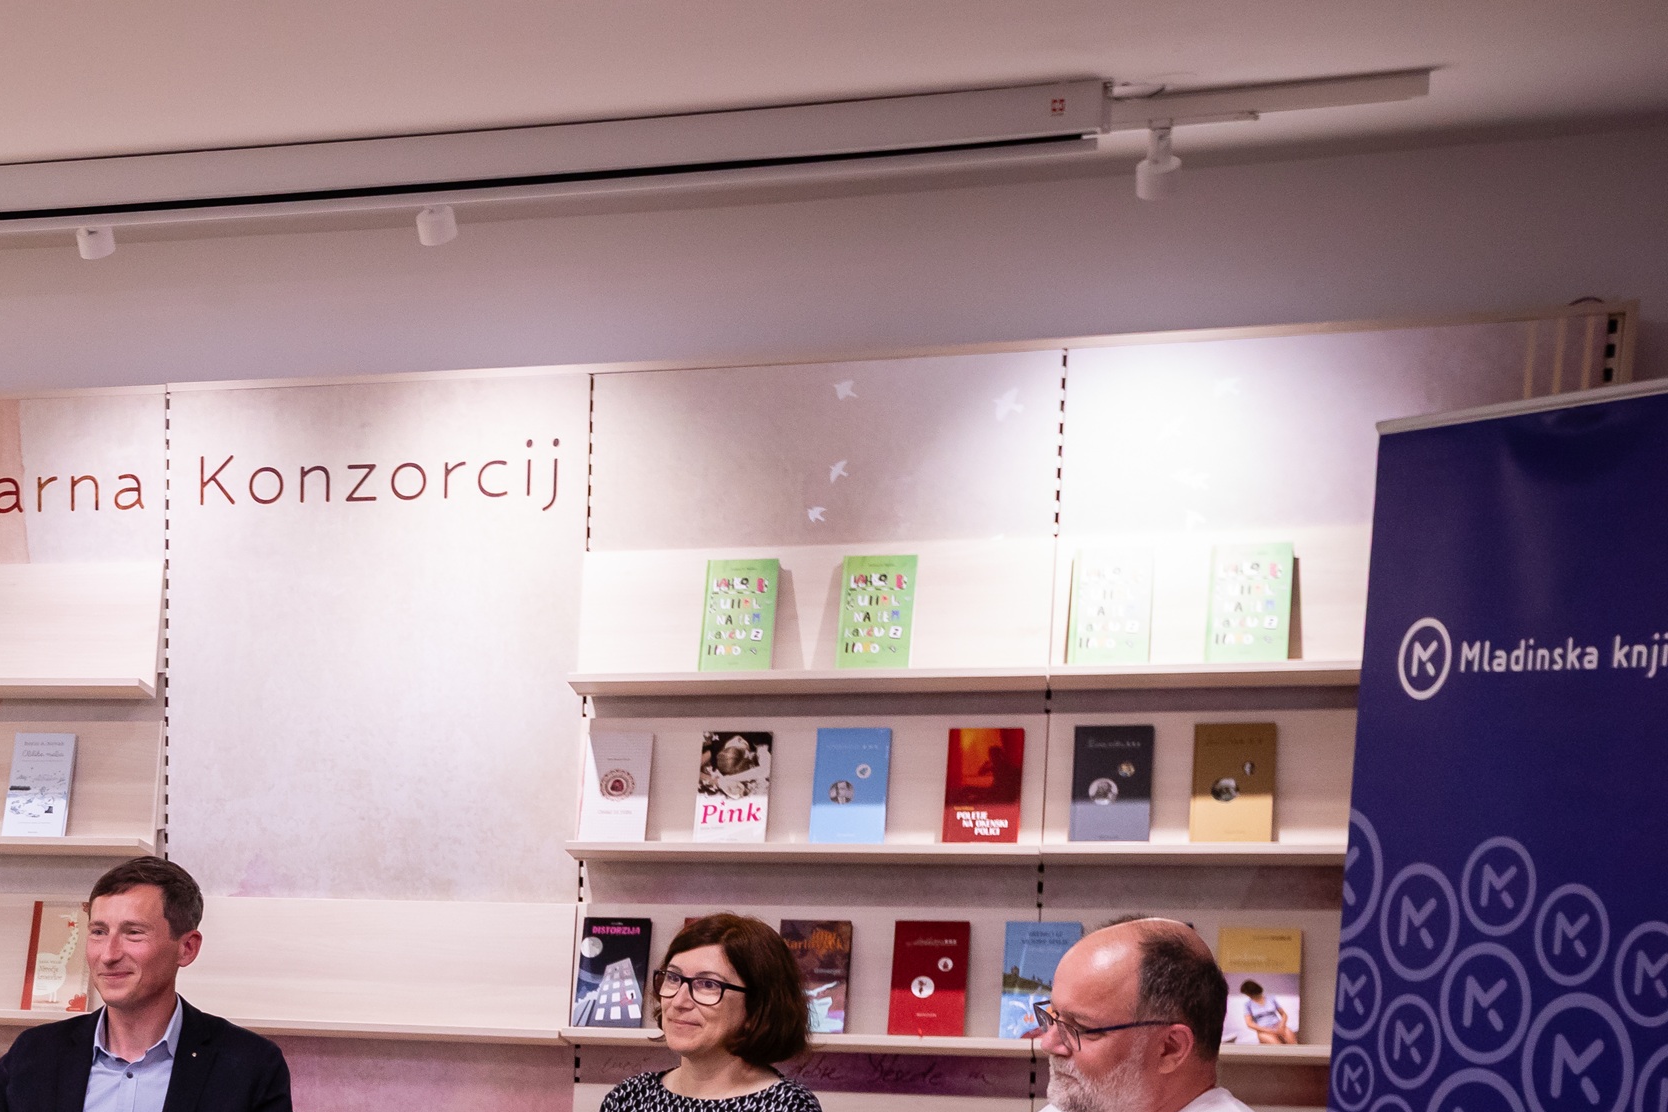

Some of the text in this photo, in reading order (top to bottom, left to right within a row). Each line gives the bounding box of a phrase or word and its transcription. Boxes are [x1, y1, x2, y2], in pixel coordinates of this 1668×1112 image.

[199, 438, 561, 512] Konzorcij
[1459, 636, 1599, 673] Mladinska
[701, 801, 762, 824] Pink
[962, 819, 973, 828] NA
[592, 925, 640, 935] DISTORZIJA
